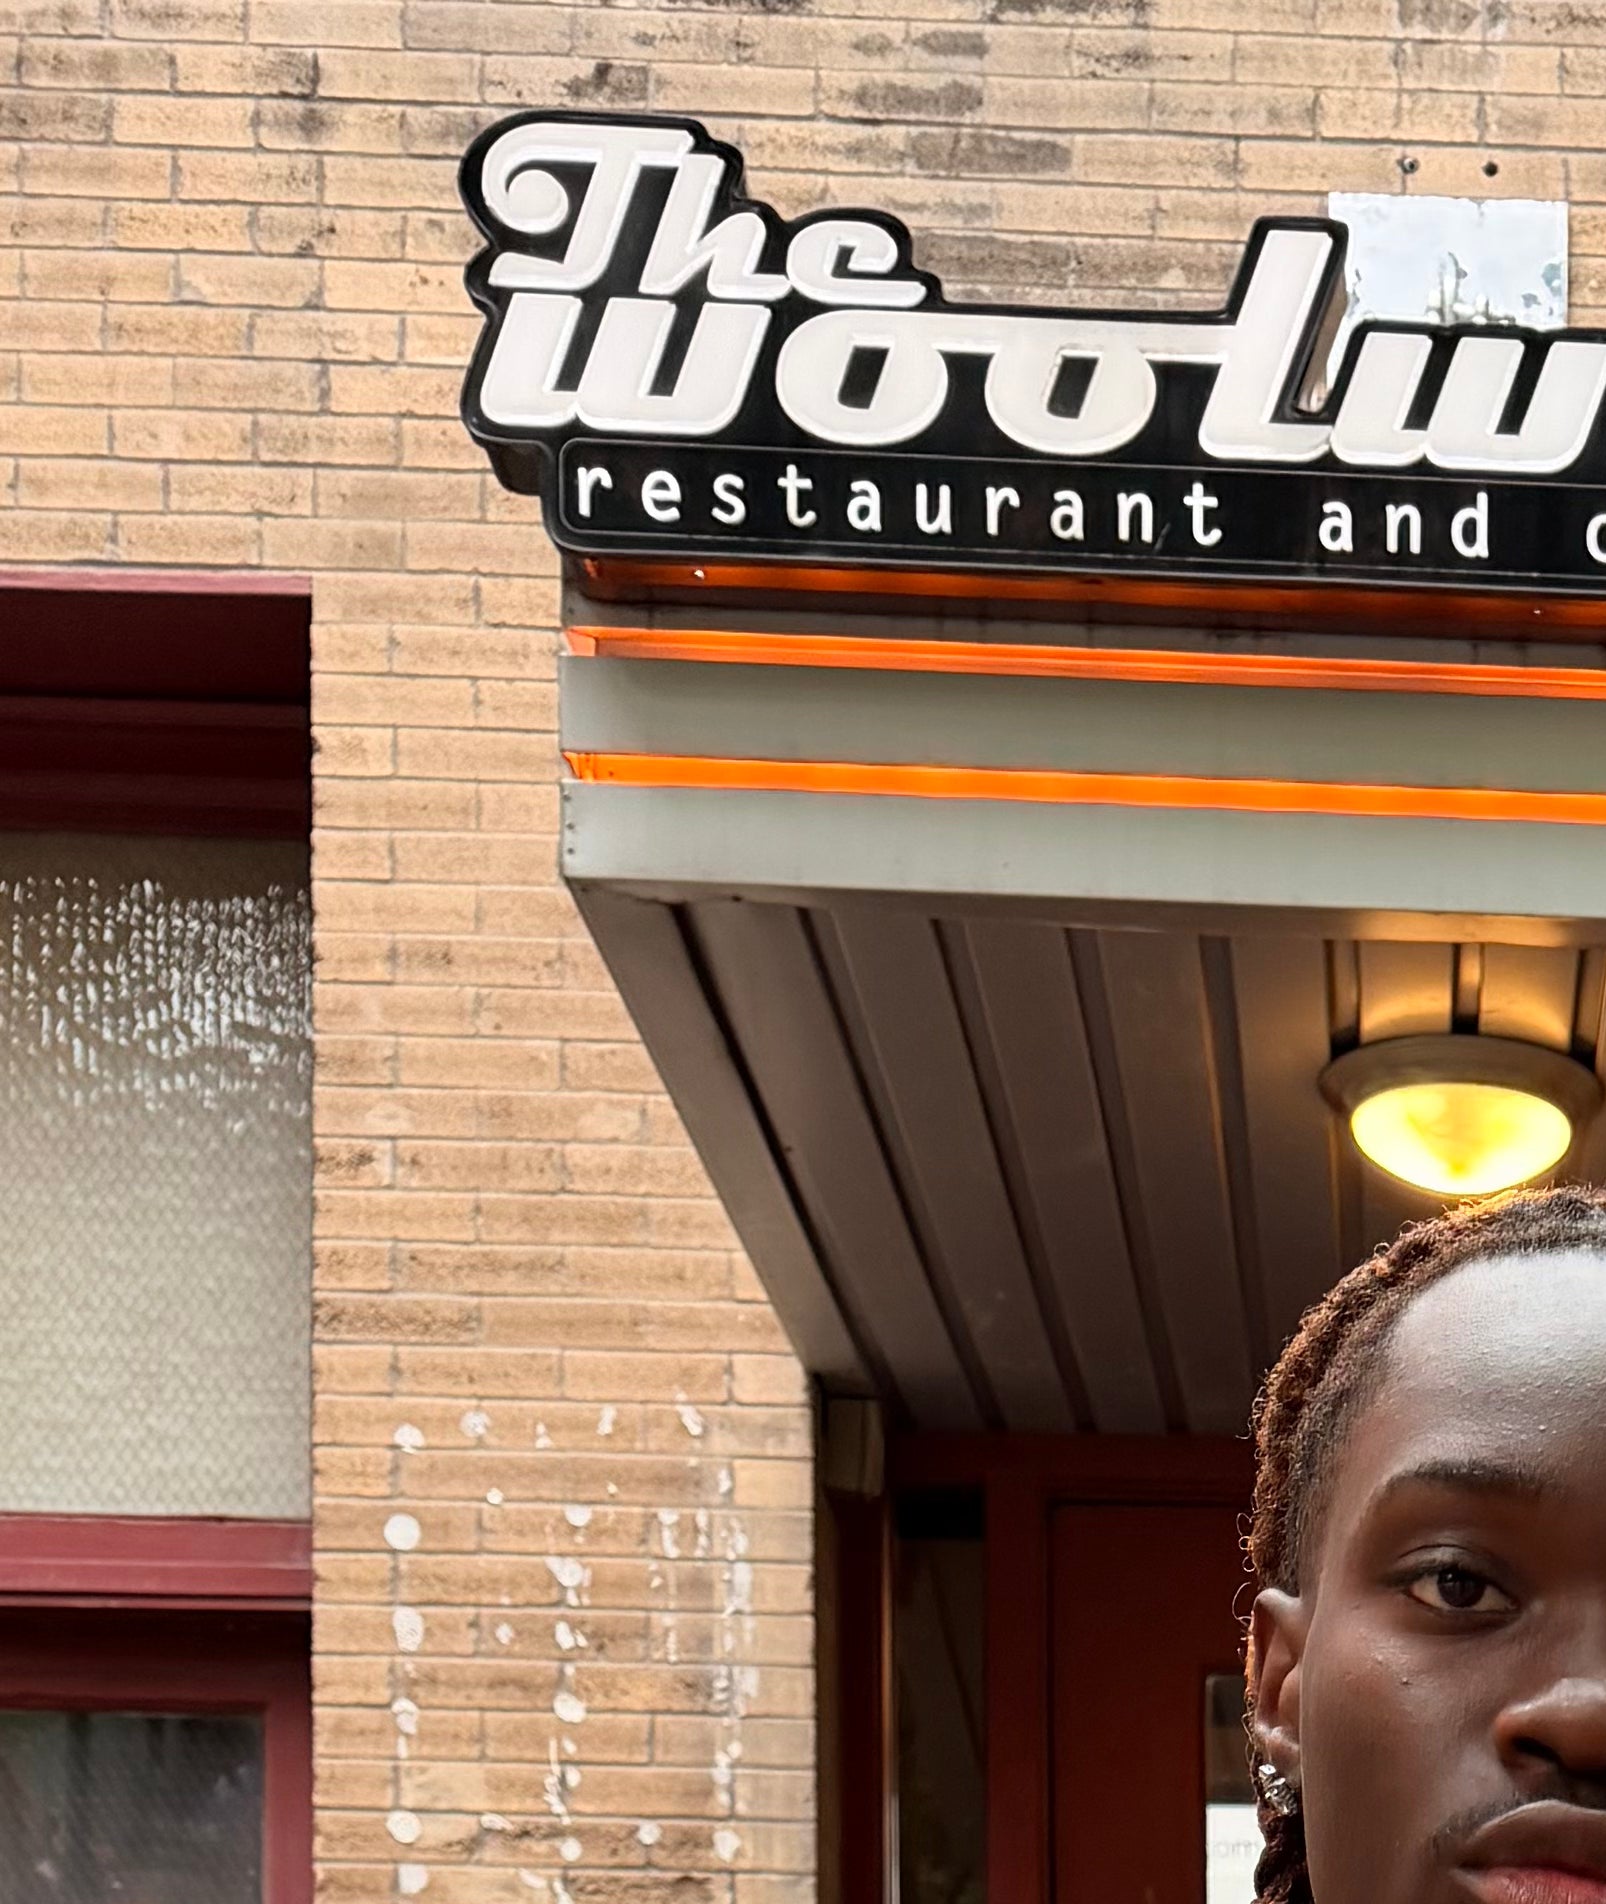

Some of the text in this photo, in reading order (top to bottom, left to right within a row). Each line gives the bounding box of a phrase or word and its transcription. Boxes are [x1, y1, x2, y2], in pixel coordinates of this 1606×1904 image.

[481, 121, 928, 308] The
[575, 458, 1224, 549] restaurant
[1317, 490, 1491, 561] and
